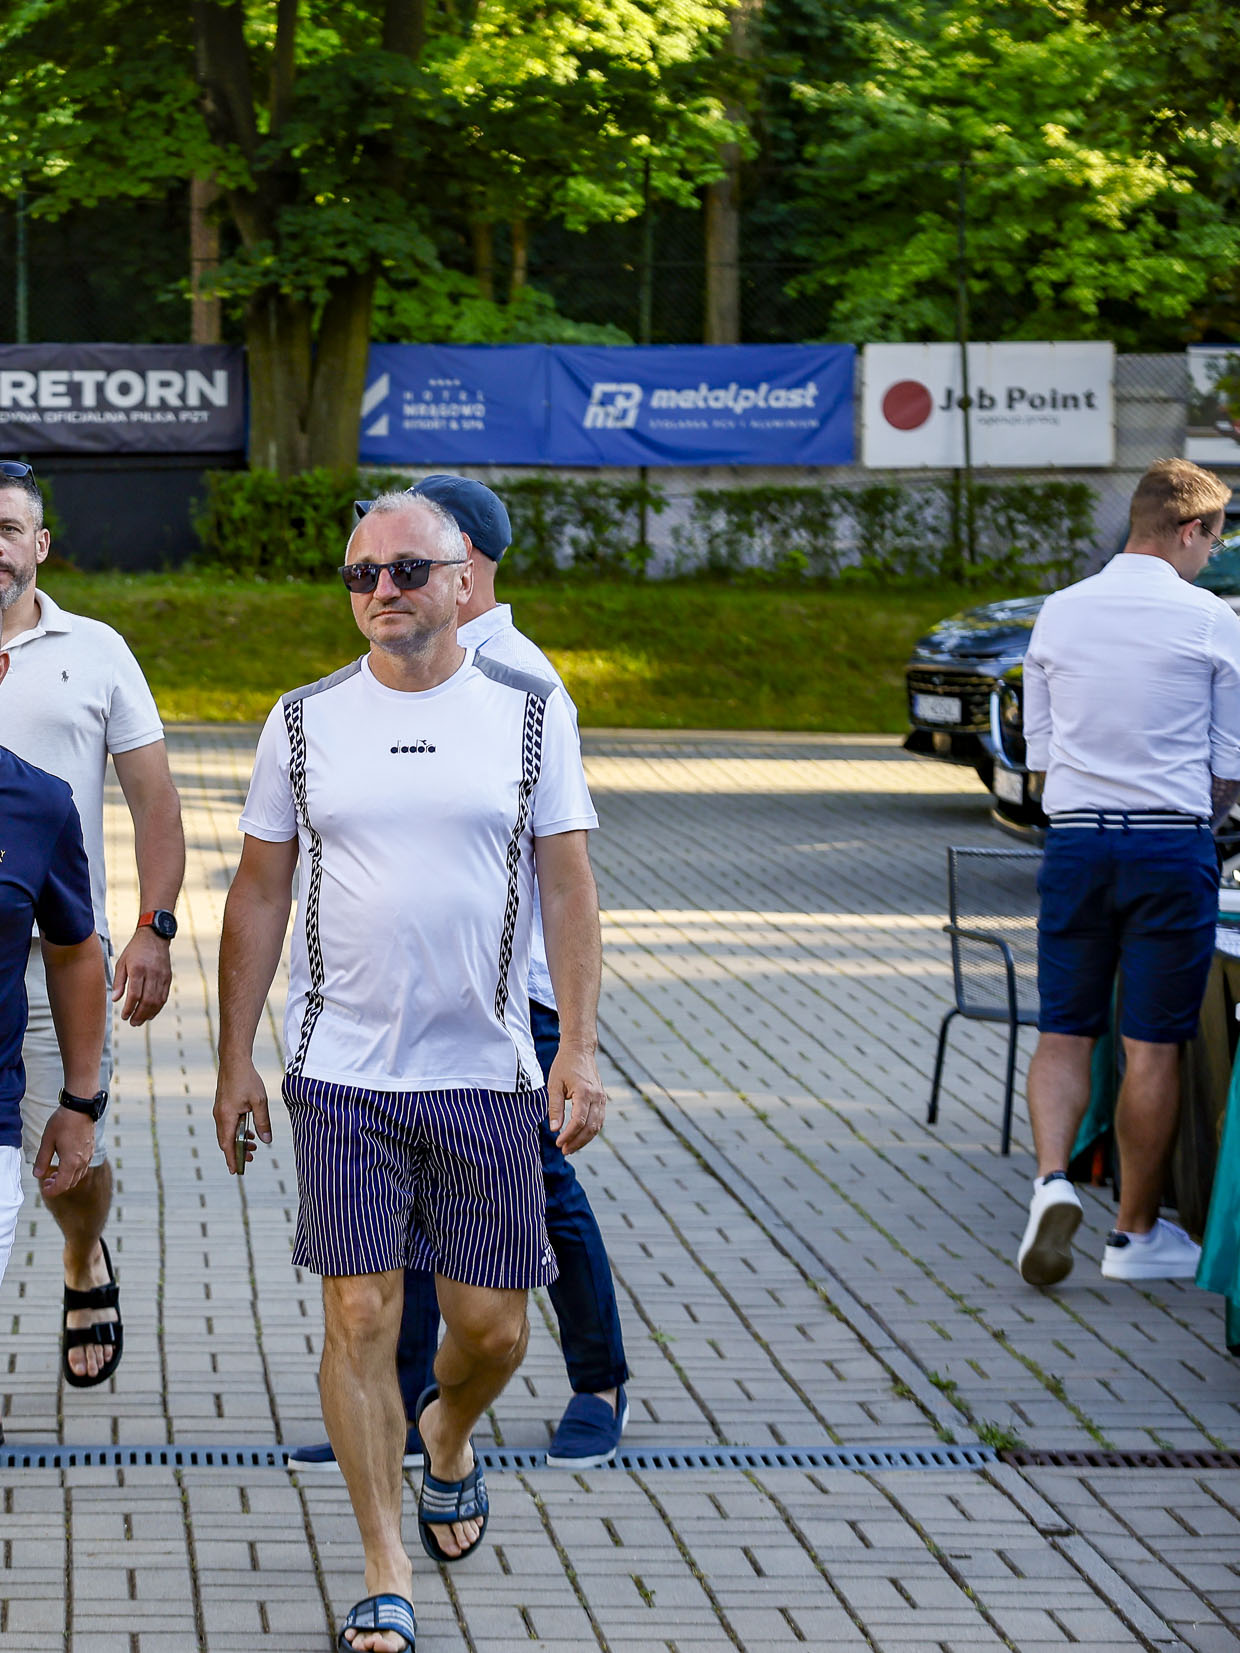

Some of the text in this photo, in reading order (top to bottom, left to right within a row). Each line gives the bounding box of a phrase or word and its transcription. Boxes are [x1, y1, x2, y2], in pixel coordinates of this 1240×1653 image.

[651, 382, 818, 414] metalplast
[940, 386, 1097, 411] Job Point
[390, 739, 436, 754] diadora
